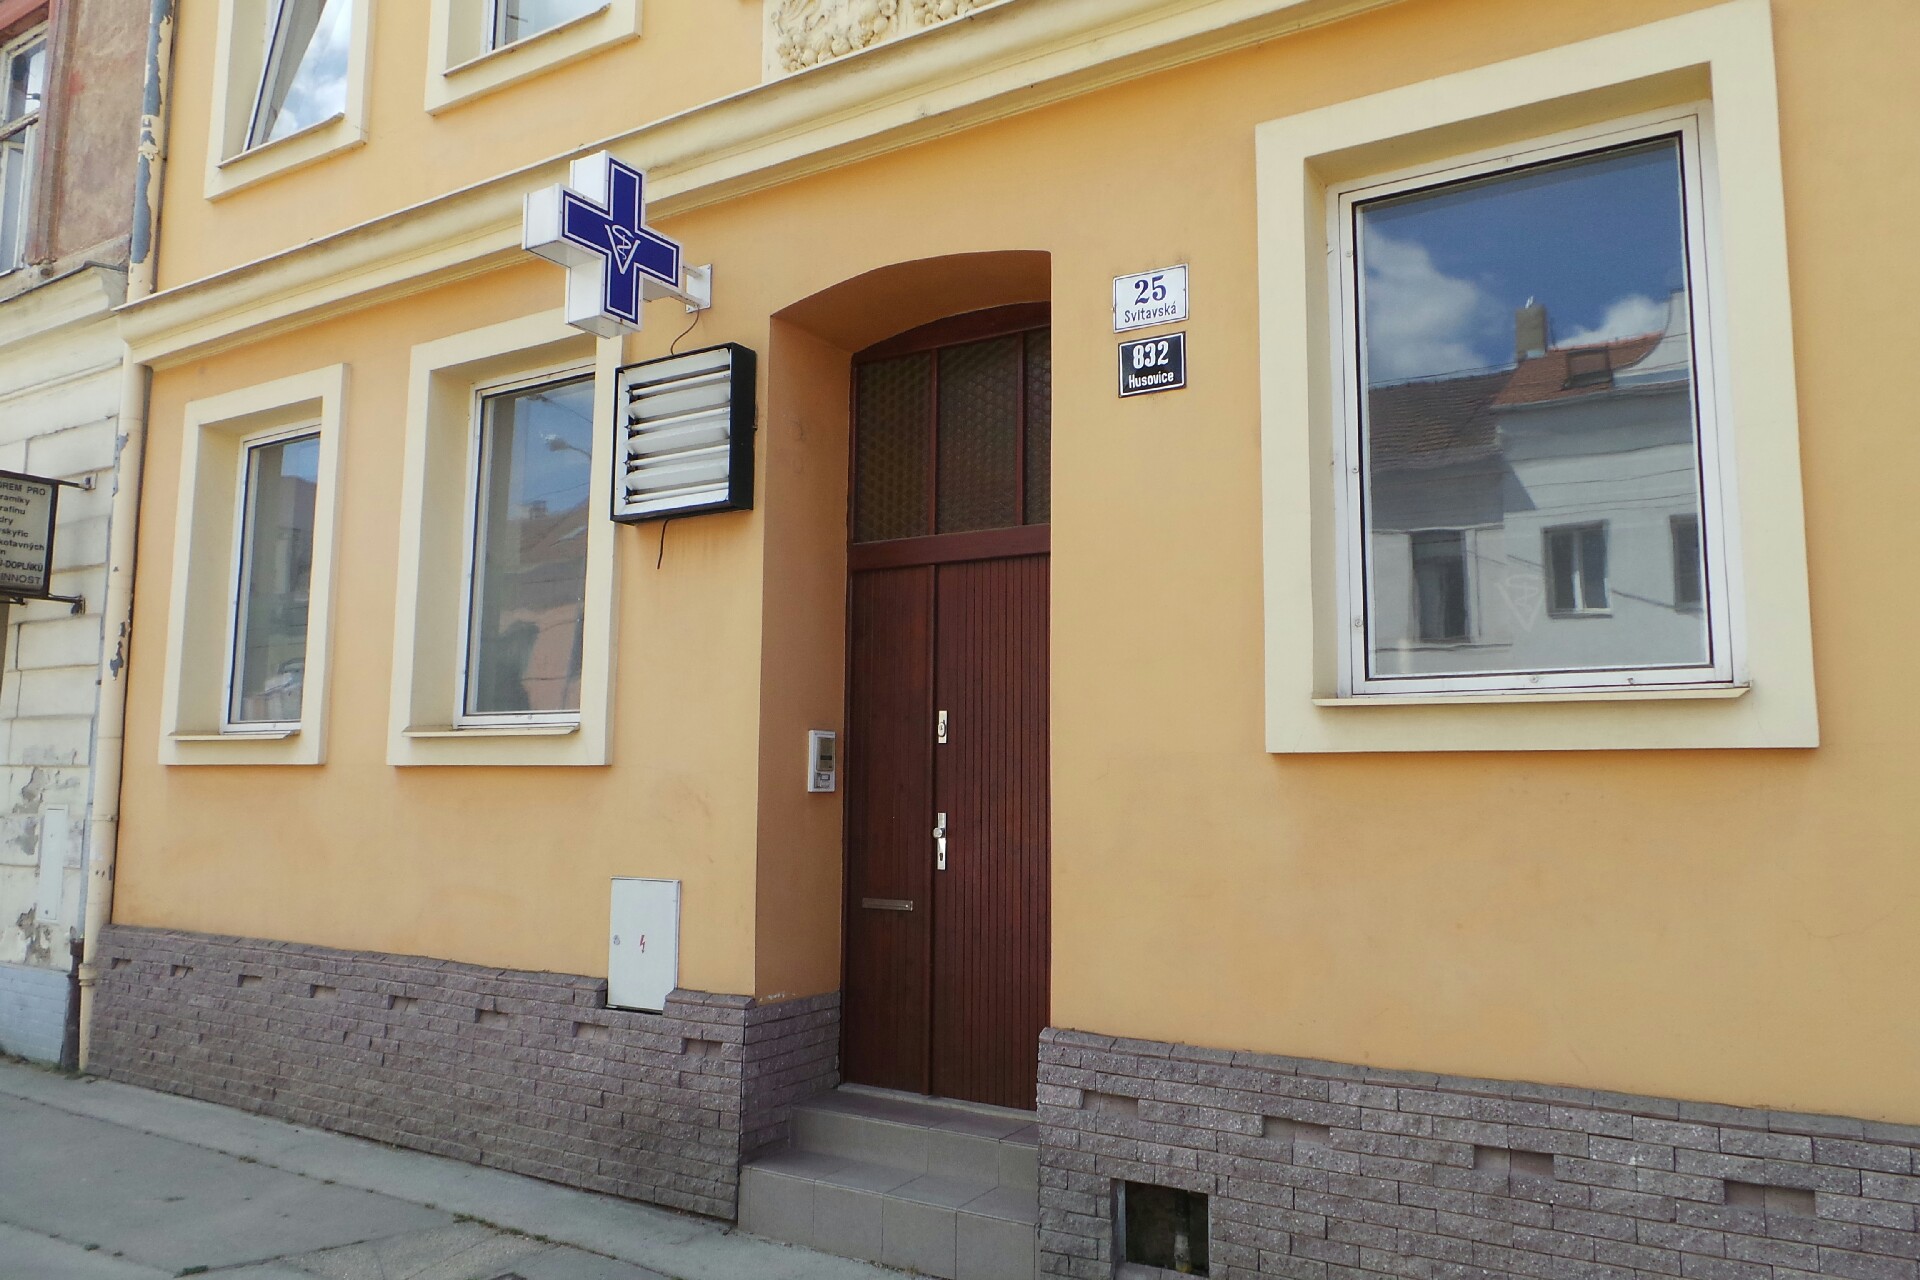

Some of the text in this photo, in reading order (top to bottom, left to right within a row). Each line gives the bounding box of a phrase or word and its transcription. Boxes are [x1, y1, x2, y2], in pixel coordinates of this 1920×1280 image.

[1134, 274, 1167, 306] 25
[1124, 300, 1177, 323] Svitavská
[1132, 340, 1169, 370] 832
[1128, 370, 1174, 389] Husovice
[26, 486, 46, 496] PRO
